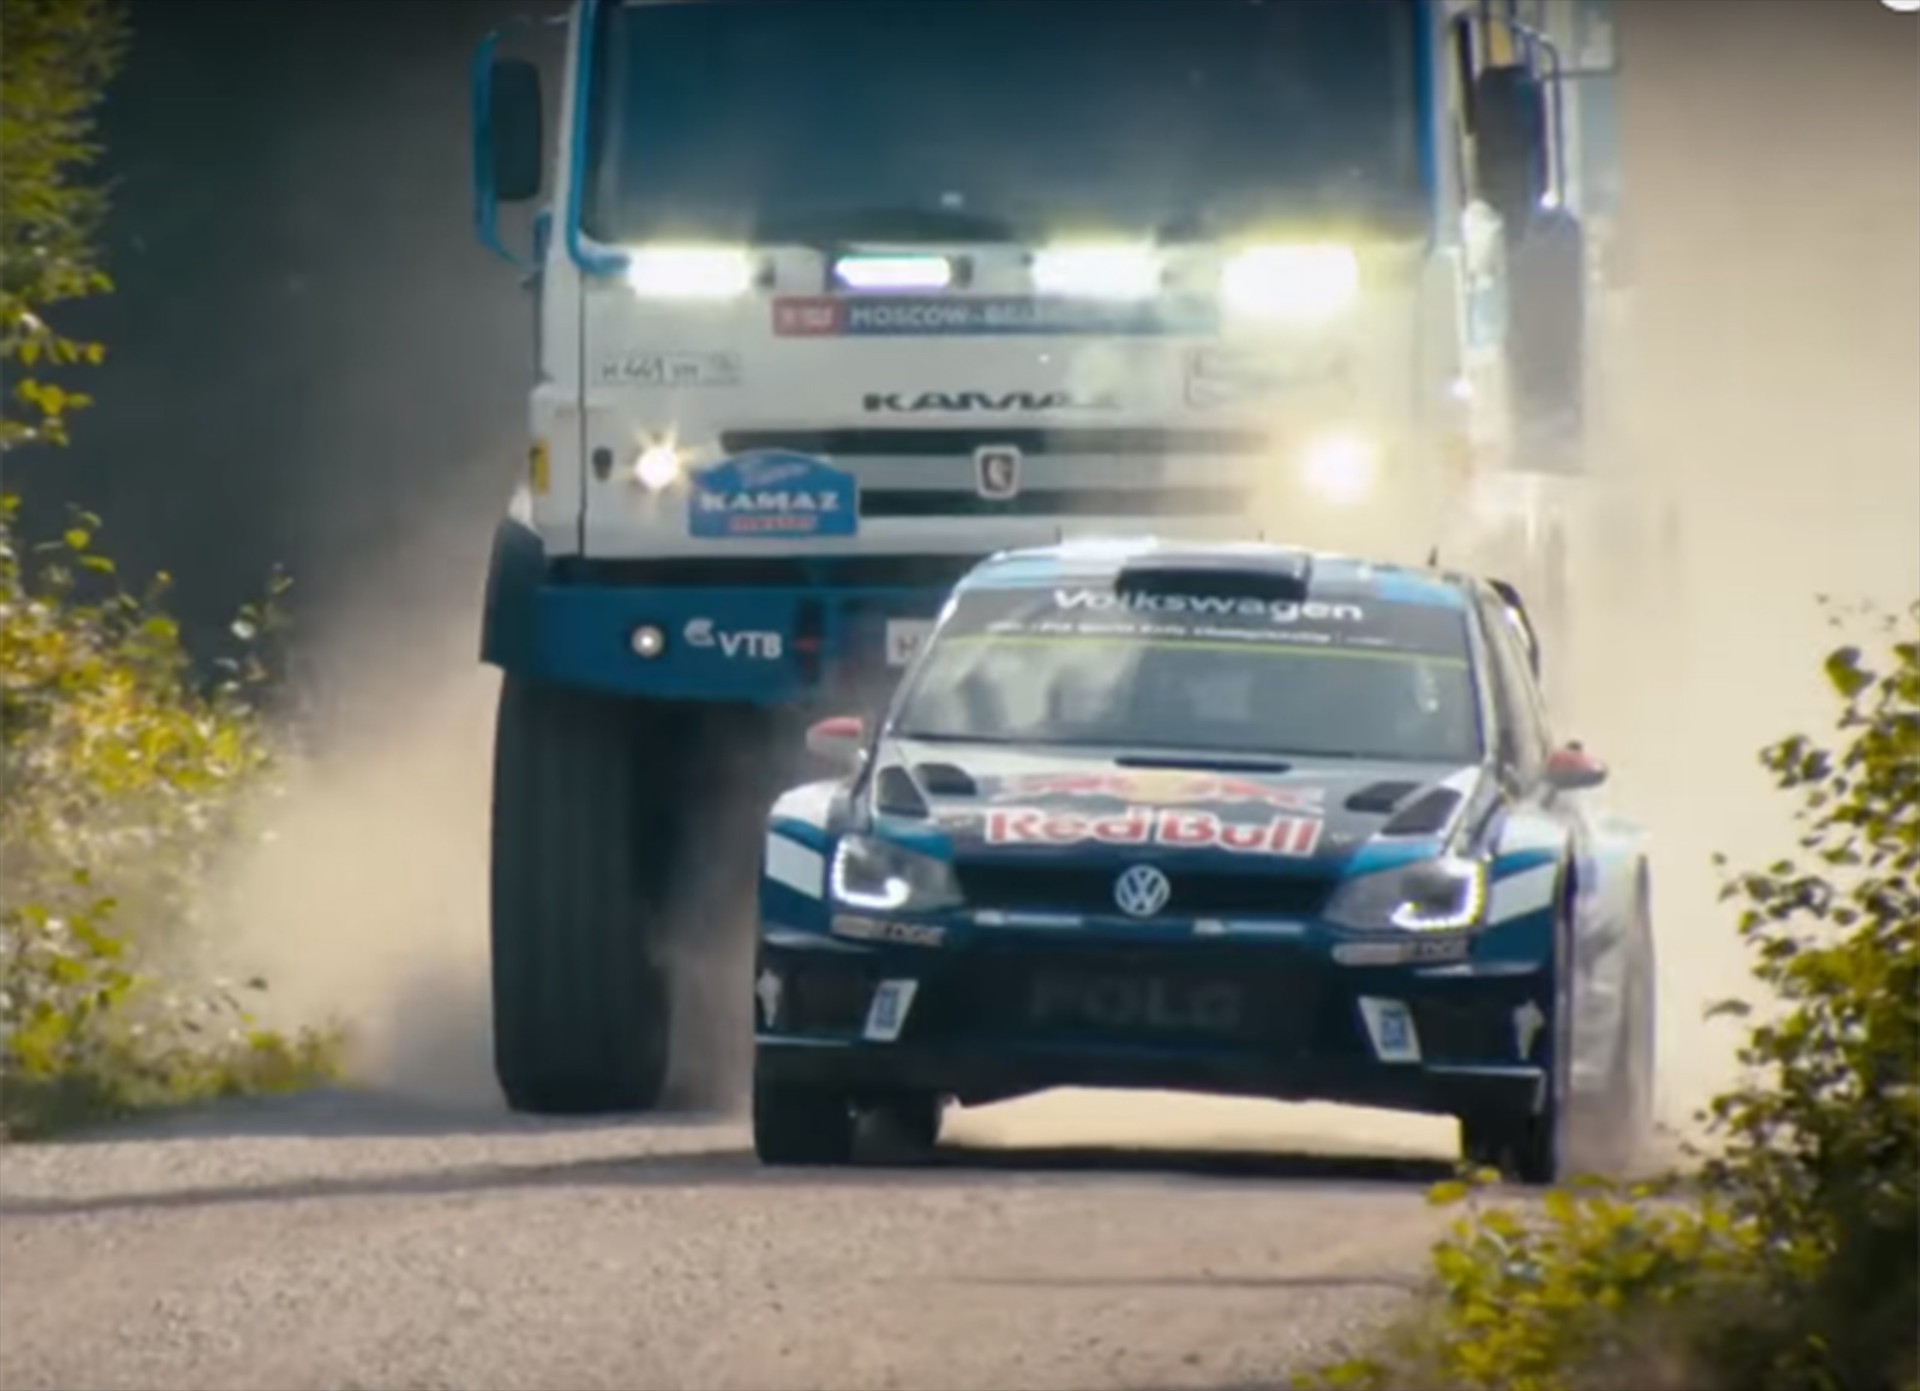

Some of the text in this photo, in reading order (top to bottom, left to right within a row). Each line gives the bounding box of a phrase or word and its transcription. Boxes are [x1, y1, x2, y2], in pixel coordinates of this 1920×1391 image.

[700, 489, 840, 512] KAMAZ
[1054, 588, 1364, 623] Volkswagen
[718, 630, 783, 660] VTB
[985, 804, 1324, 858] Red Bull
